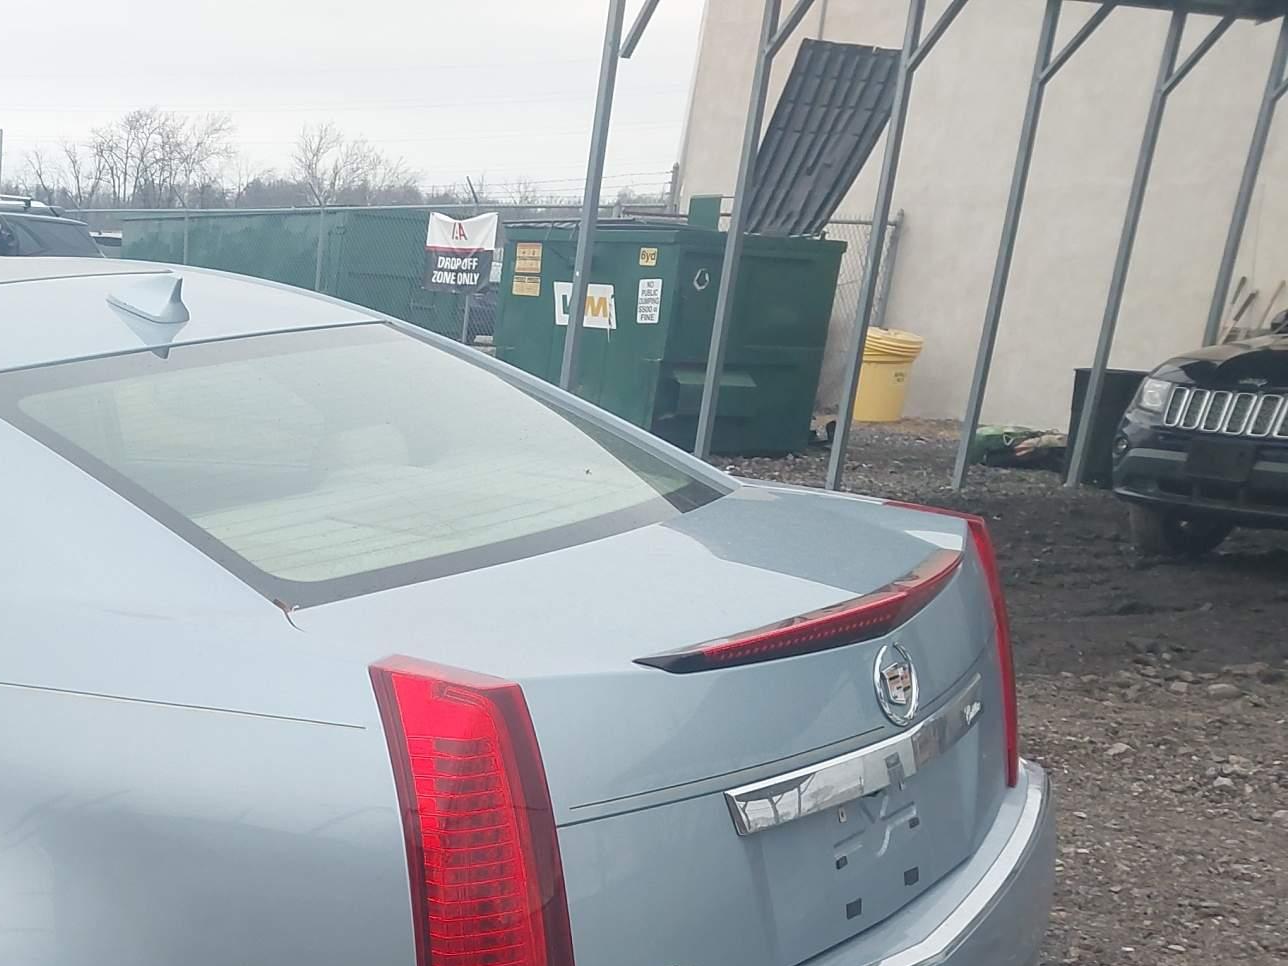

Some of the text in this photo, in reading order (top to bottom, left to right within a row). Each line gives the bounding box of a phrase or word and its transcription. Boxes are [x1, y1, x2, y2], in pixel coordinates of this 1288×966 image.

[437, 256, 478, 271] DROP OFF
[431, 271, 456, 285] ZONE
[457, 272, 480, 285] ONLY
